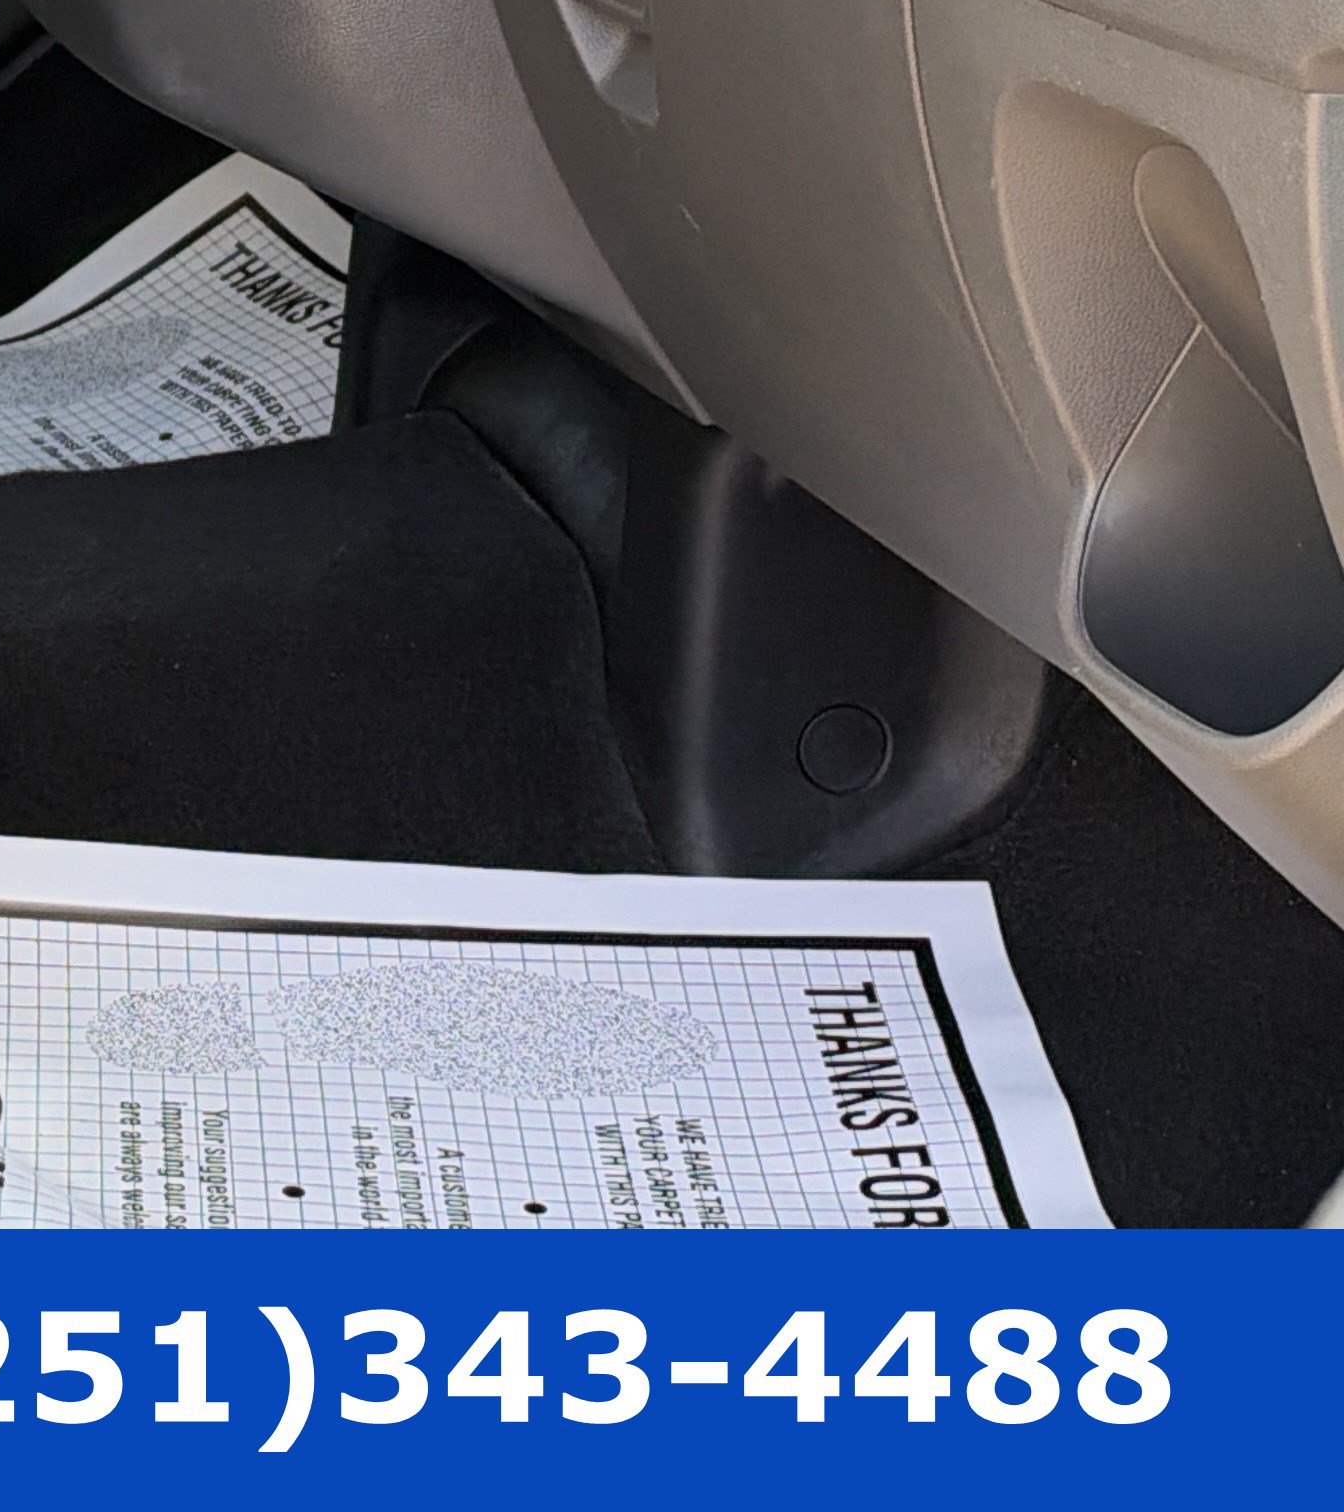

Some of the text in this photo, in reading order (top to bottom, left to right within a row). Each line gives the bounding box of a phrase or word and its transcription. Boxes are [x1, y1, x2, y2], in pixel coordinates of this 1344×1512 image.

[209, 240, 330, 324] THANKS
[242, 380, 284, 417] TRIED
[277, 414, 302, 437] TO
[120, 1101, 142, 1126] are
[387, 1095, 416, 1121] the
[803, 981, 951, 1228] THANKS FOR
[155, 1101, 191, 1178] improving
[202, 1109, 230, 1144] Your
[392, 1124, 423, 1165] most
[594, 1123, 627, 1166] WITH
[633, 1114, 669, 1161] YOUR
[675, 1118, 707, 1145] WE
[115, 1131, 149, 1183] always
[351, 1125, 390, 1222] in the world
[436, 1147, 465, 1159] A
[681, 1151, 719, 1191] HAVE
[163, 1183, 187, 1209] our
[604, 1173, 639, 1206] THIS
